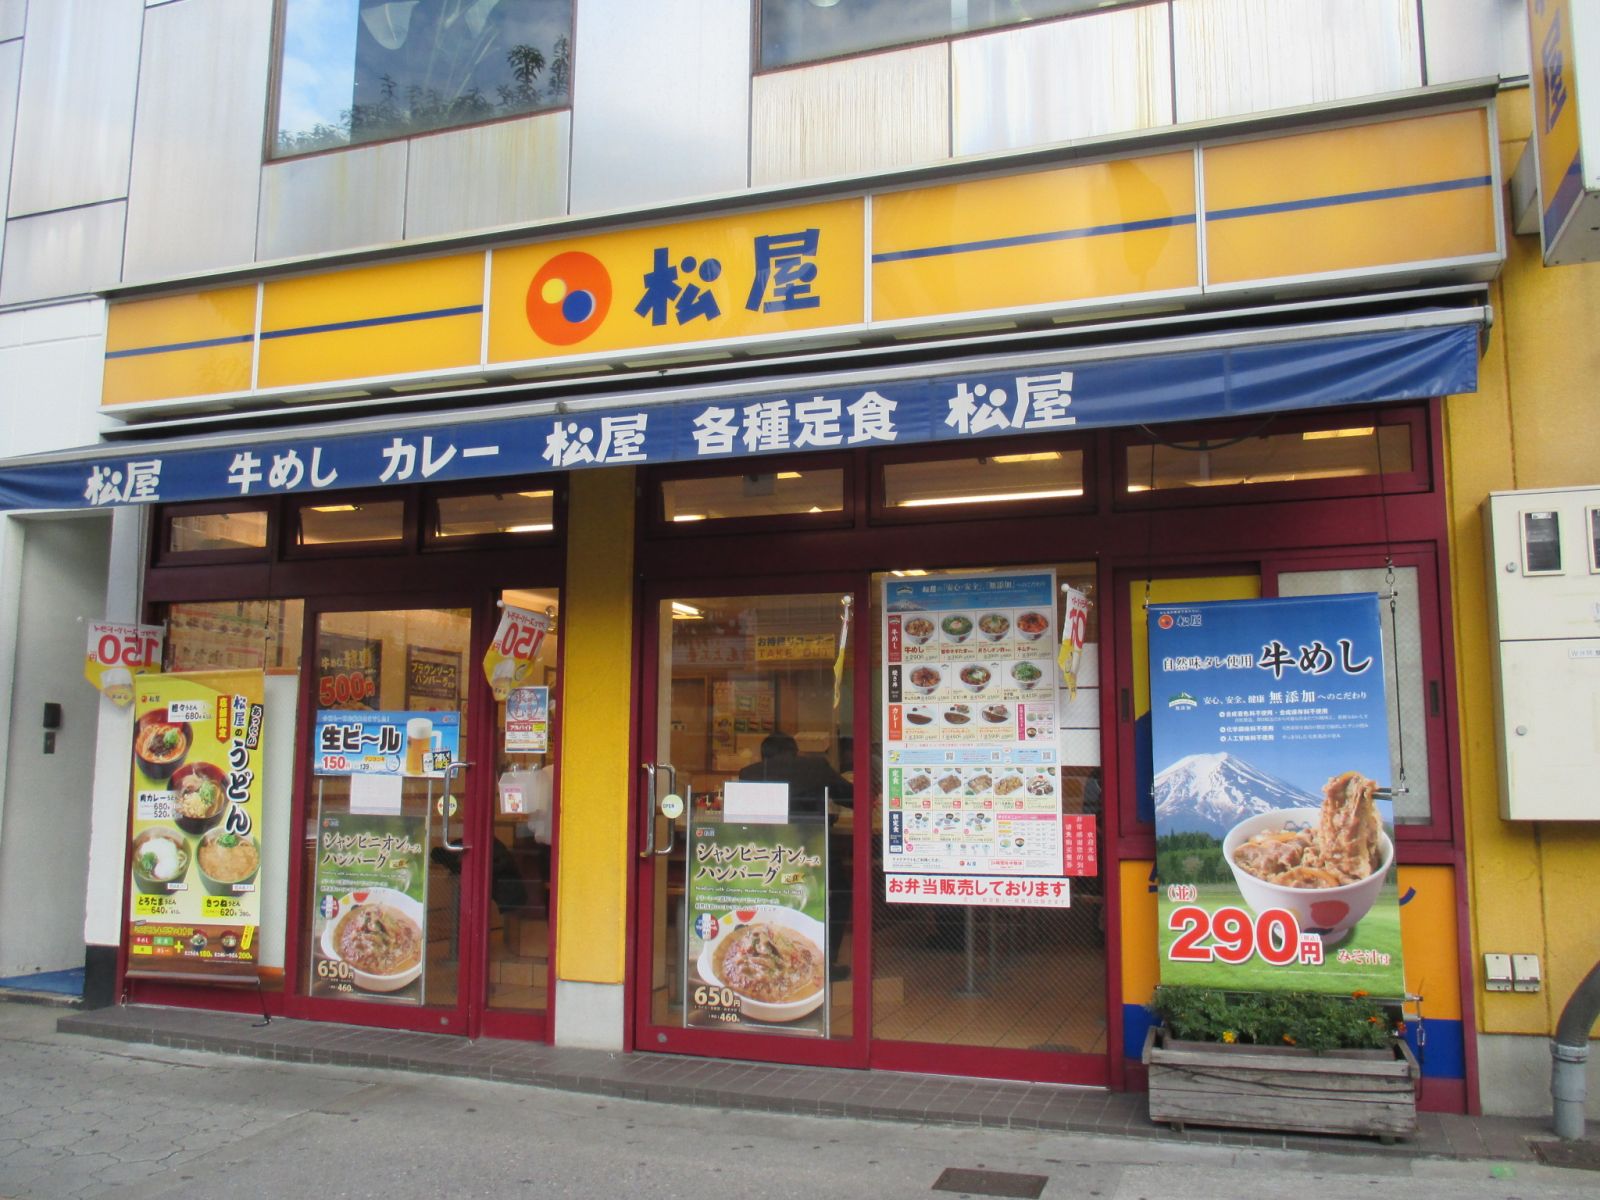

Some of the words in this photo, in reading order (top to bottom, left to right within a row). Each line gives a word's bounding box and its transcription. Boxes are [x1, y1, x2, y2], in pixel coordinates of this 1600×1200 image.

[633, 228, 821, 326] 松屋
[692, 390, 899, 455] 各種定食
[945, 371, 1076, 435] 松屋
[379, 436, 500, 482] カレー
[542, 413, 648, 467] 松屋
[85, 459, 162, 506] 松屋
[228, 446, 338, 494] 牛めし
[1258, 639, 1372, 680] 牛めし
[696, 865, 780, 887] ハンバーグ
[889, 877, 1066, 897] お弁当販売しております
[1168, 906, 1324, 966] 290円
